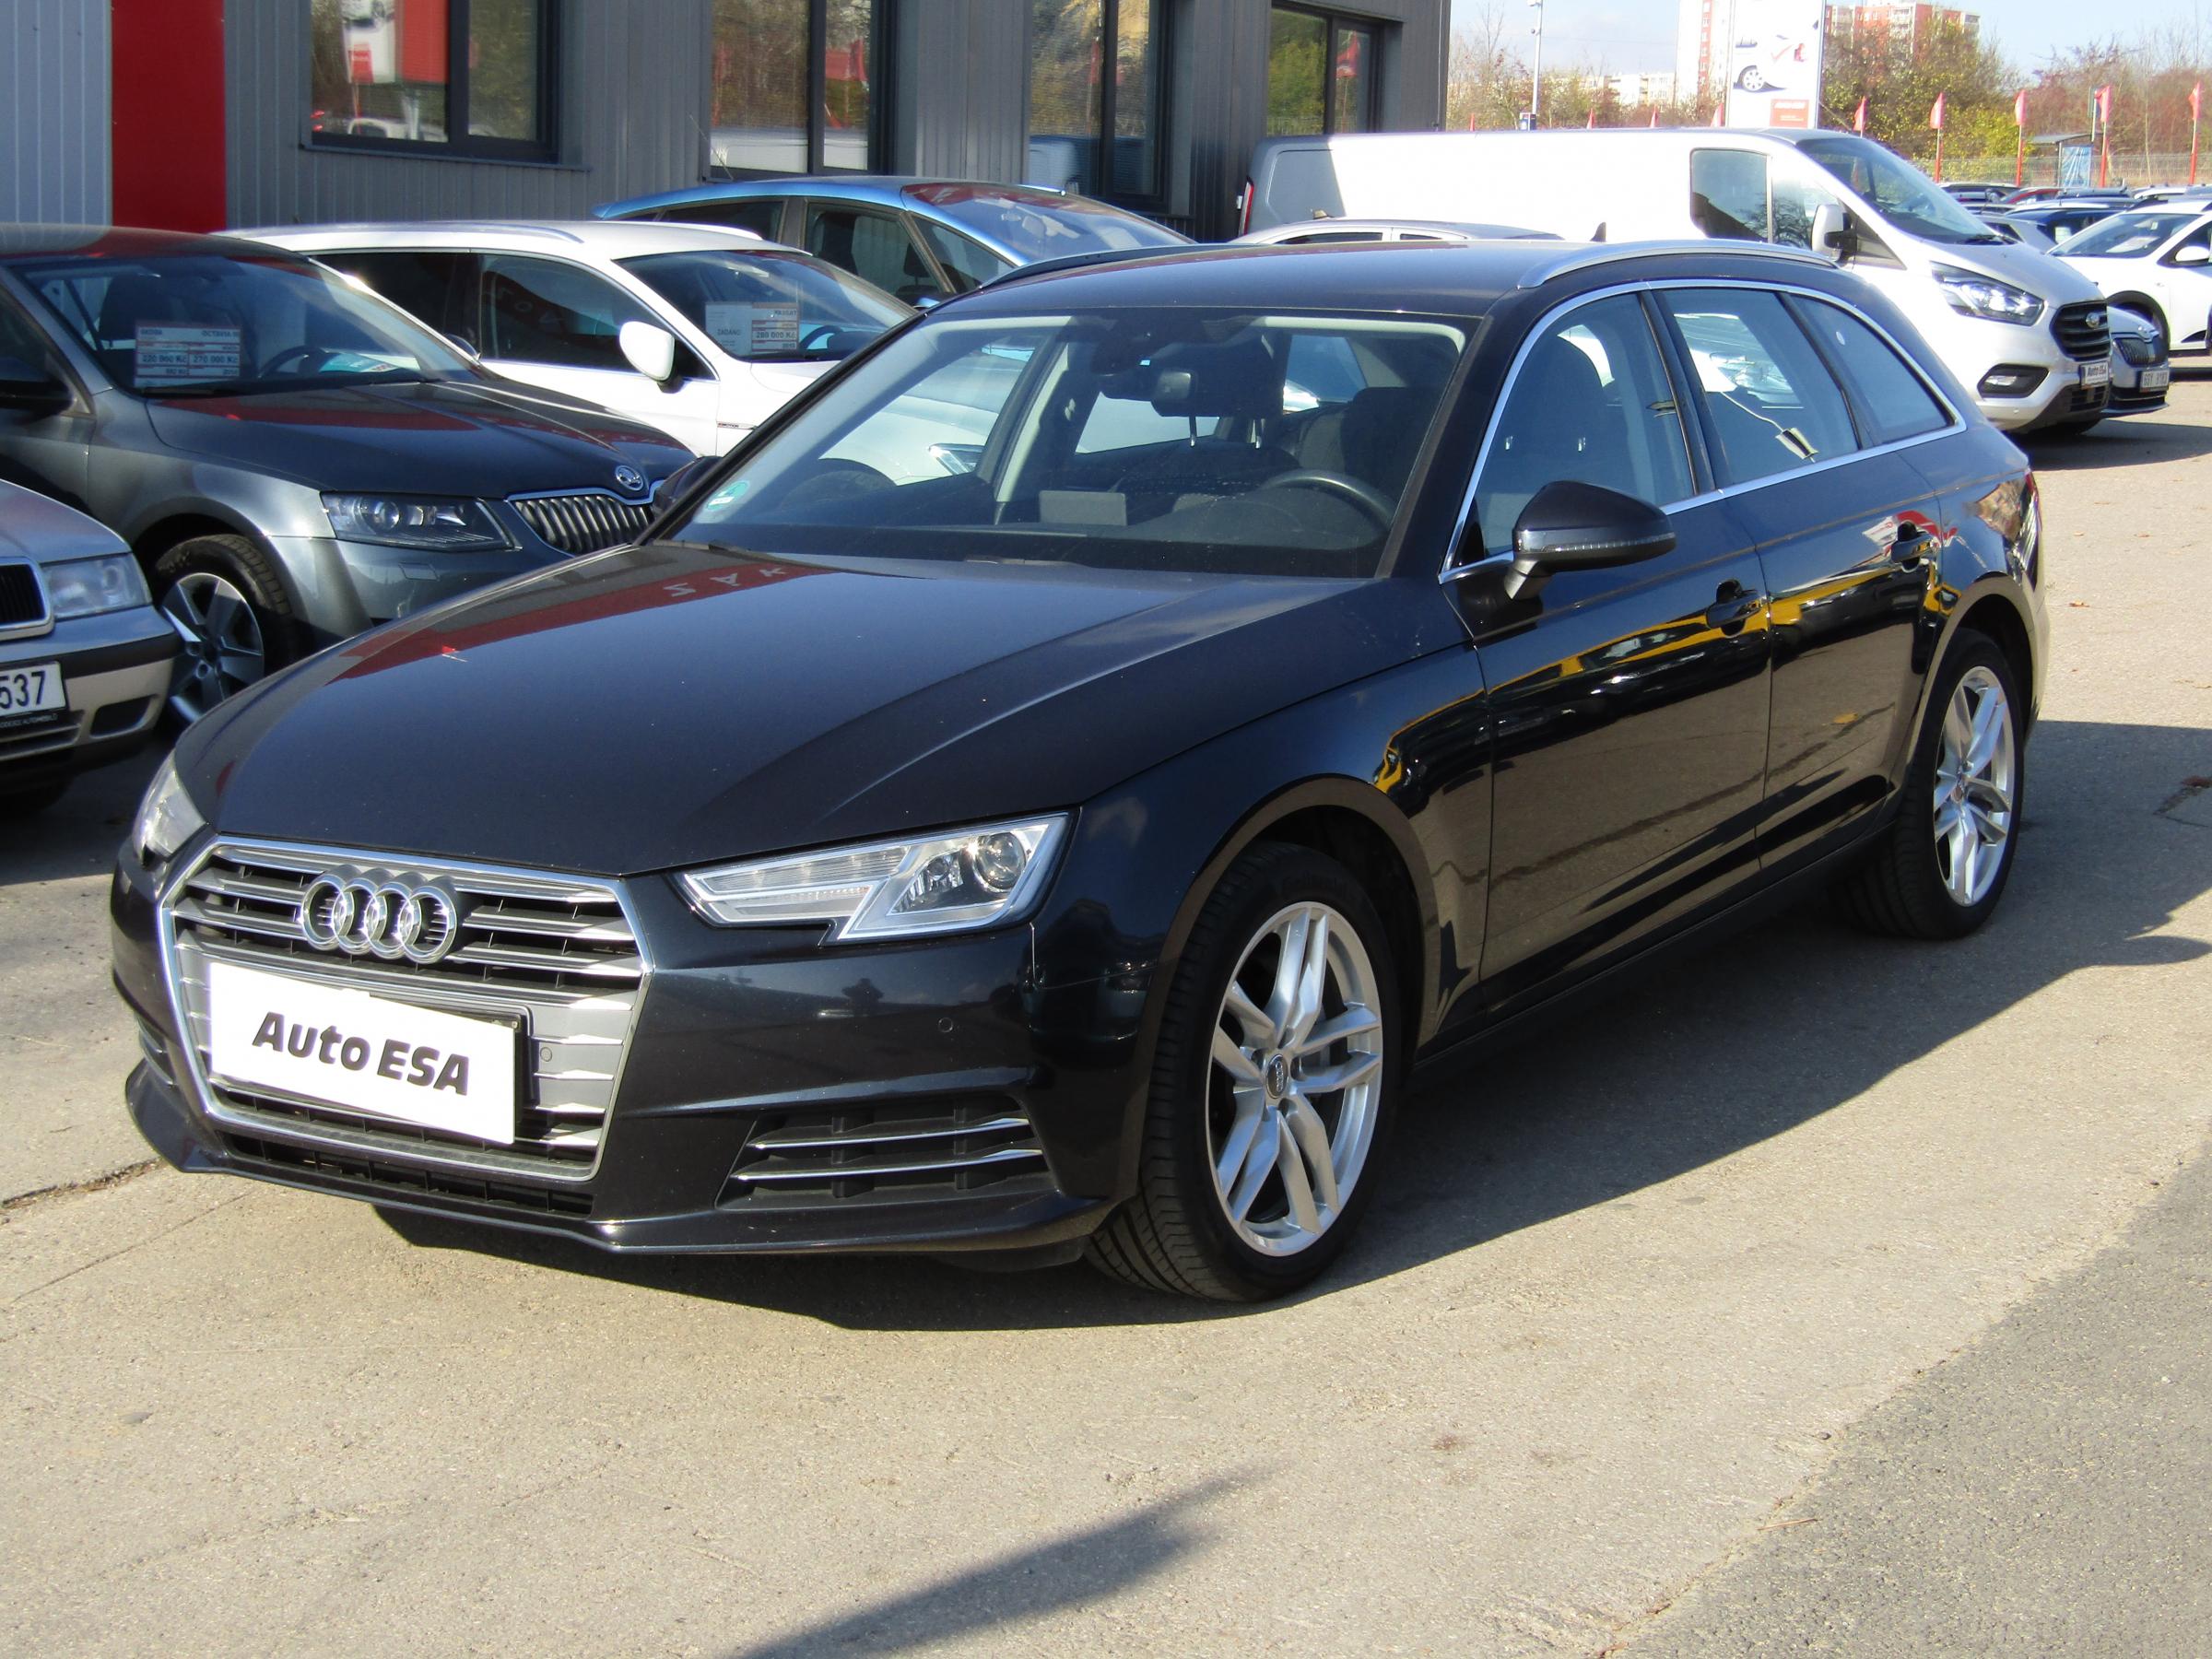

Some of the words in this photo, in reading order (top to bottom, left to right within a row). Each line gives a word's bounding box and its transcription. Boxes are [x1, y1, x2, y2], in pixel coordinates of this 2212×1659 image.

[0, 670, 45, 710] 537
[252, 1011, 371, 1071] Auto
[377, 1039, 469, 1096] ESA
